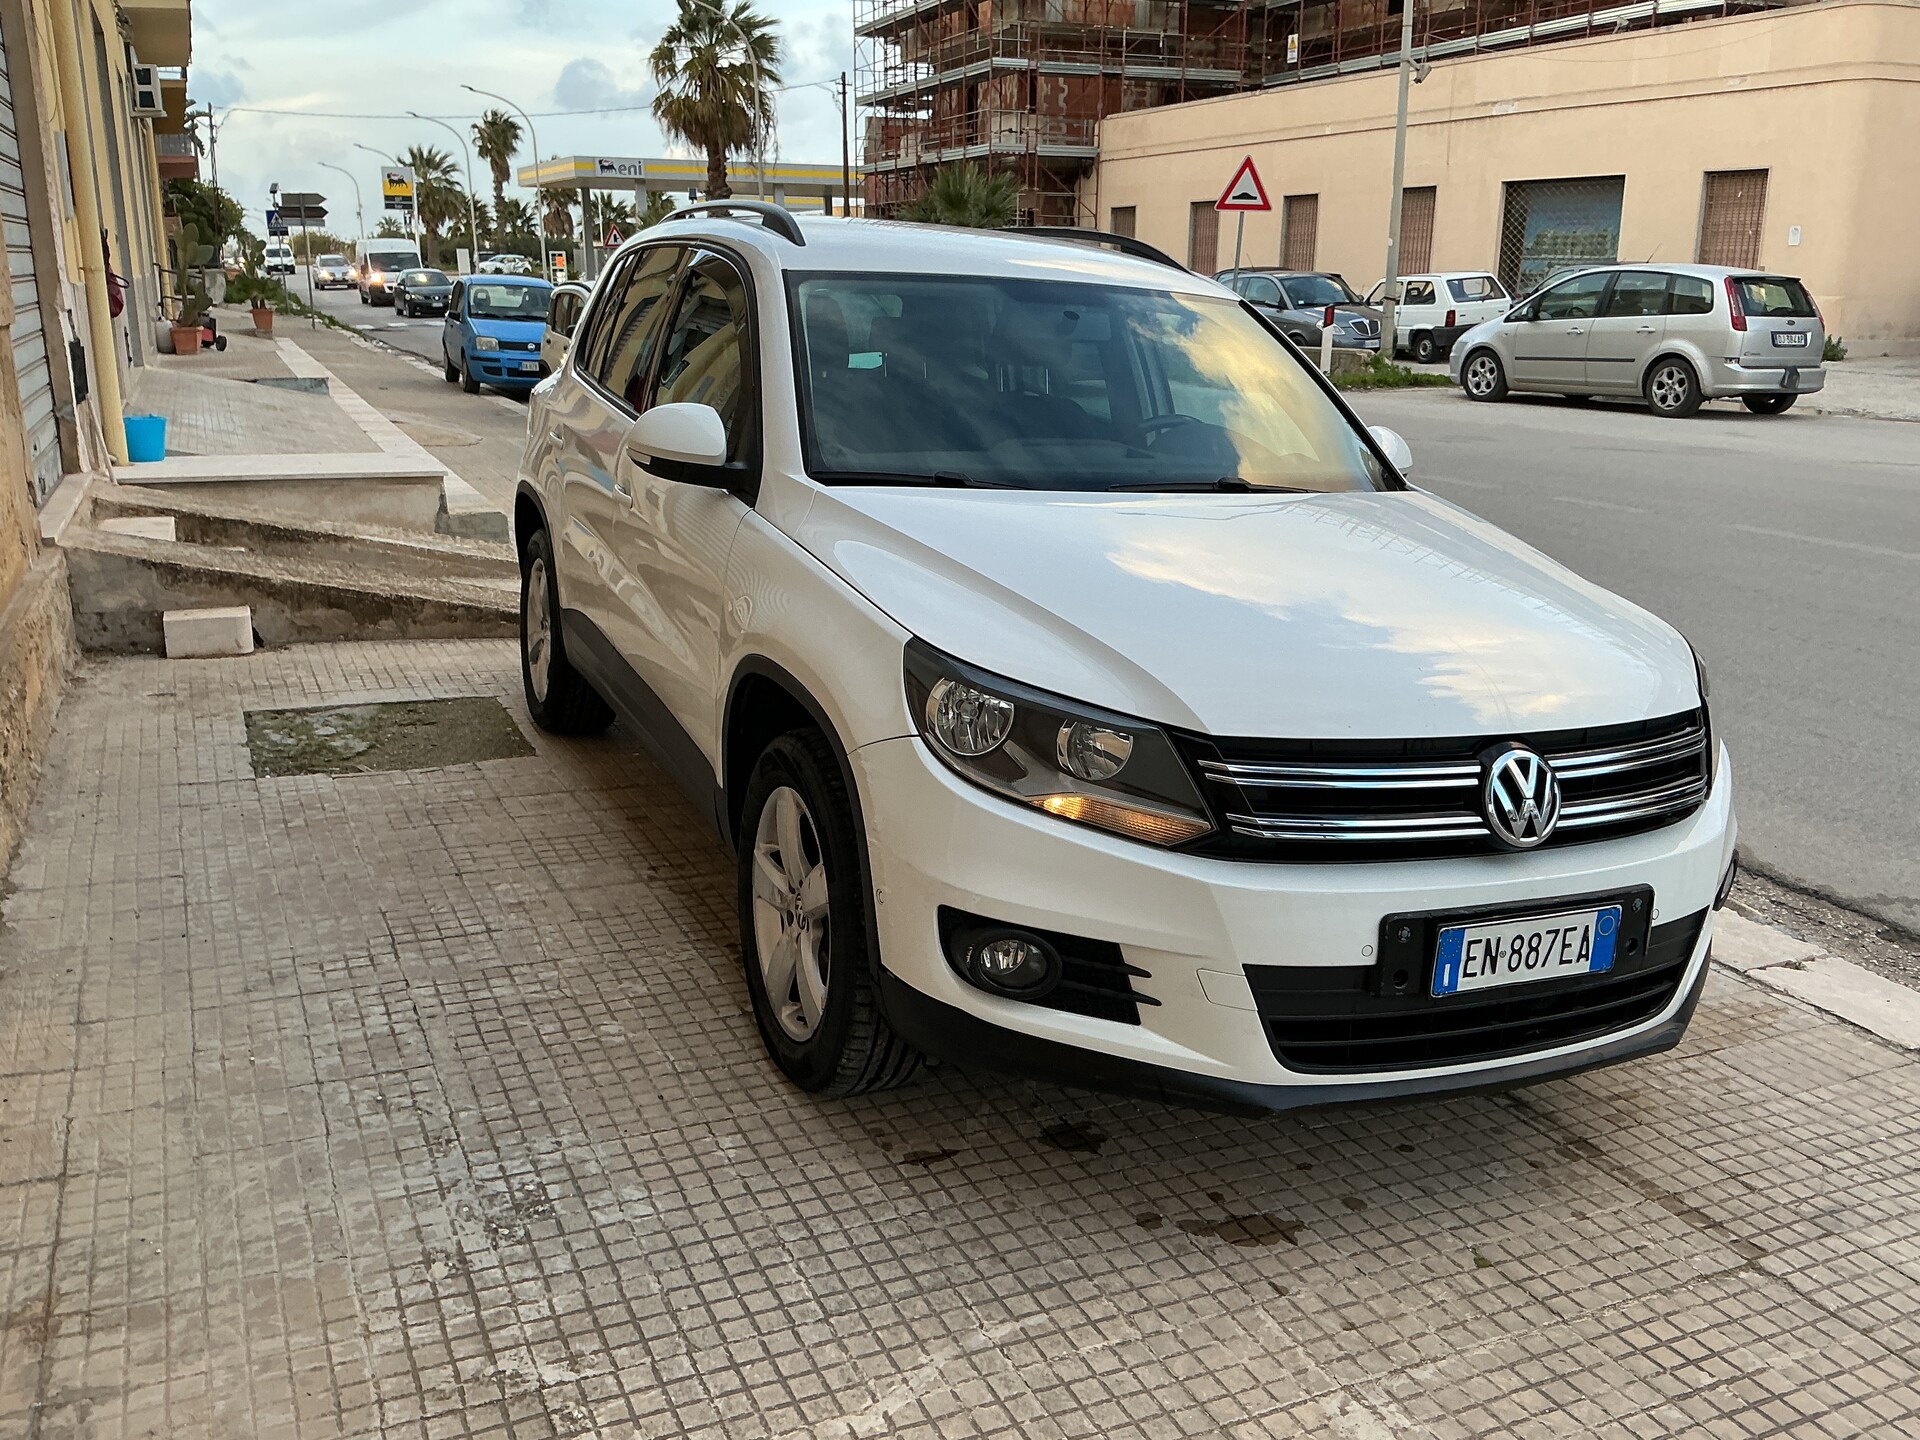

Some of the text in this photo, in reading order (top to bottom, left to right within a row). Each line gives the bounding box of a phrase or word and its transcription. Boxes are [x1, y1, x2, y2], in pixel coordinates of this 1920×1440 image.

[618, 161, 642, 175] eni
[1490, 754, 1554, 842] VW
[1462, 924, 1591, 979] EN 887EA
